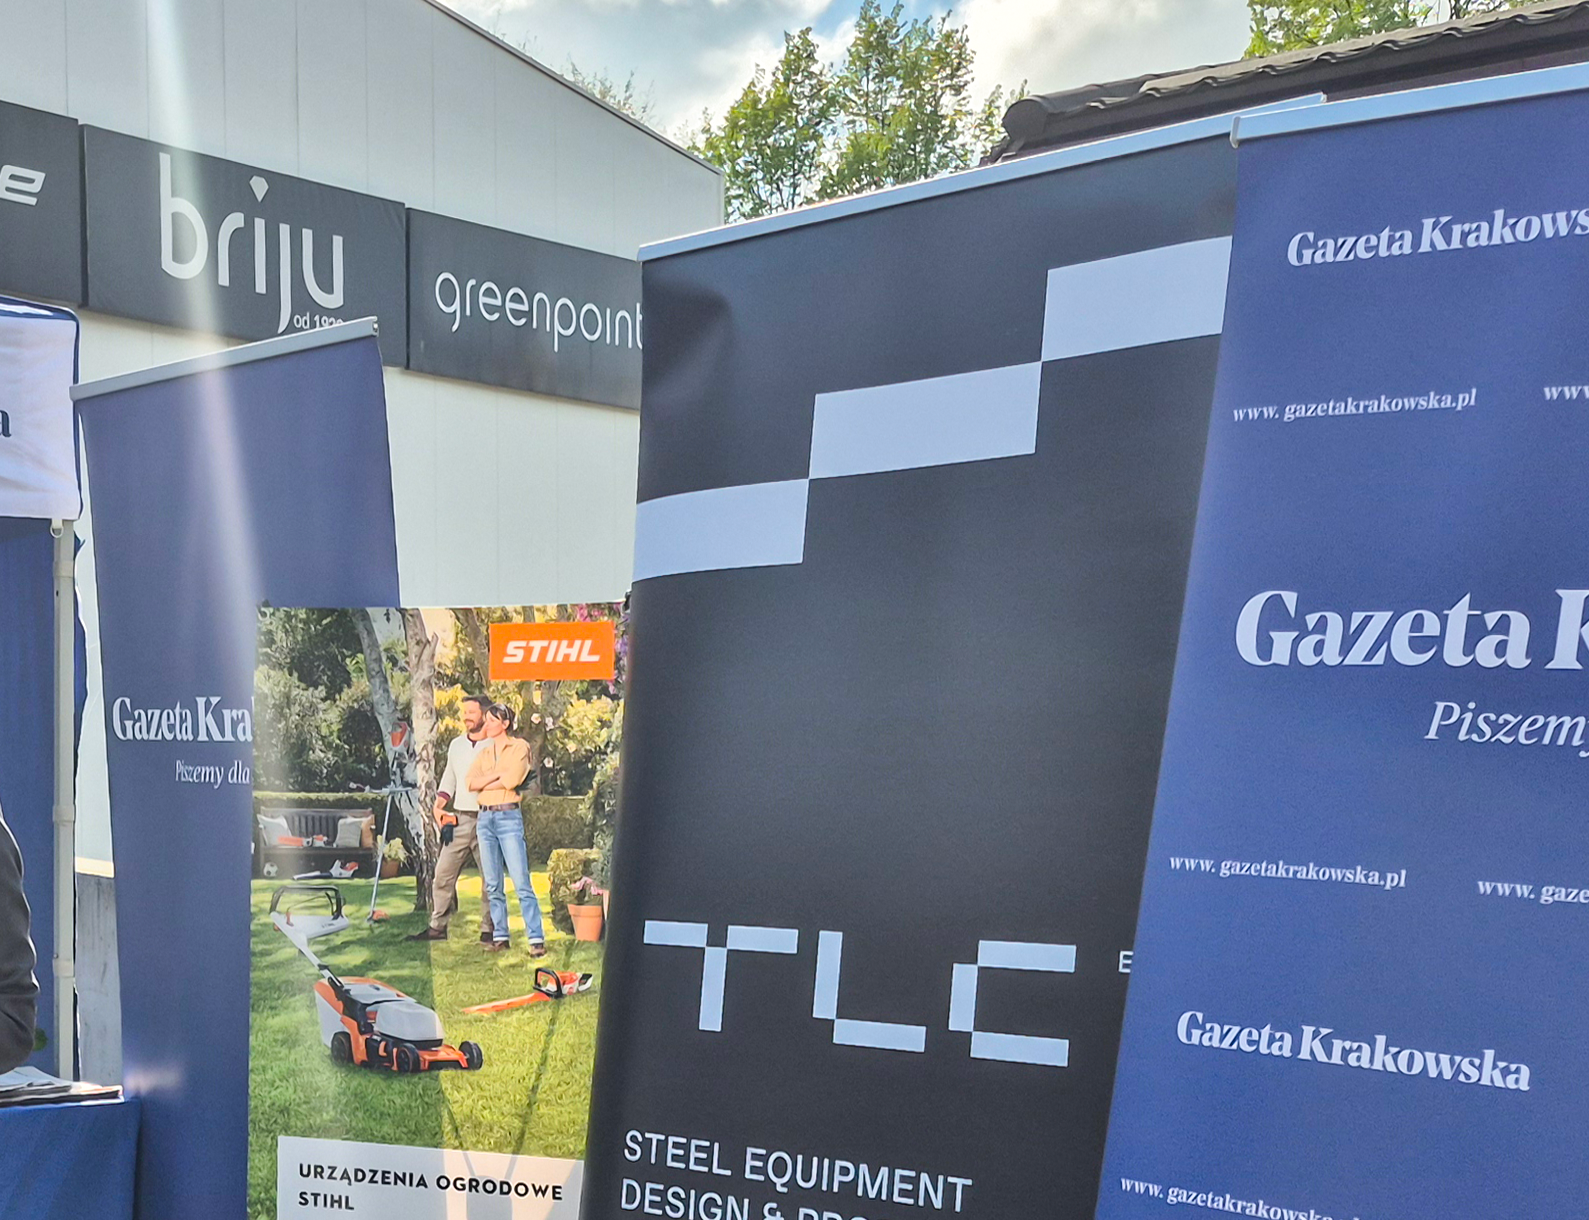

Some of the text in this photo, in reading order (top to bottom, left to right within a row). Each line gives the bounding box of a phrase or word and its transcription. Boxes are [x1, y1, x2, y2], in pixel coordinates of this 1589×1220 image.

[159, 152, 345, 334] briju
[1287, 226, 1413, 268] Gazeta
[293, 311, 310, 330] od
[435, 271, 643, 353] greenpoint
[1283, 388, 1477, 422] gazetakrakowska.pl
[502, 637, 601, 664] STIHL
[1235, 589, 1532, 670] Gazeta
[112, 695, 255, 743] Gazeta Kra
[175, 759, 251, 790] Piszemy dla
[1219, 858, 1407, 891] gazetakrakowska.pl
[643, 919, 1077, 1068] TLC
[1176, 1010, 1531, 1091] Gazeta Krakowska
[298, 1162, 563, 1201] URZĄDZENIA OGRODOWE
[624, 1129, 973, 1213] STEEL EQUIPMENT
[298, 1191, 355, 1211] STIHL
